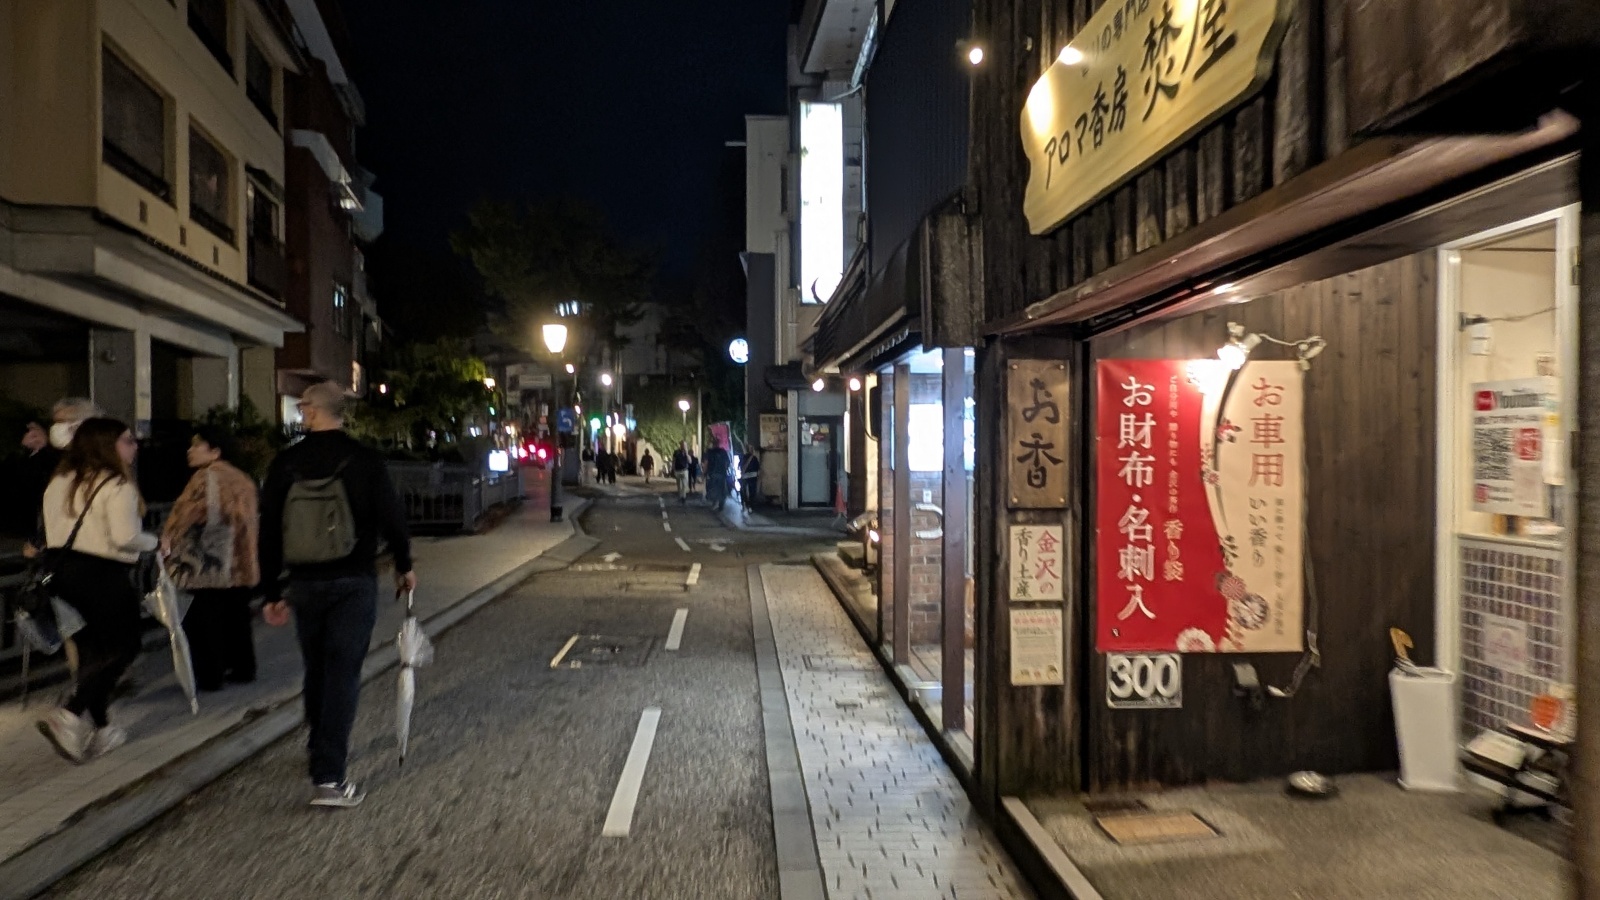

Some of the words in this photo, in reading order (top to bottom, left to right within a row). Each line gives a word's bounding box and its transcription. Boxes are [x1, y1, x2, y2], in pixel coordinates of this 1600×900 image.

[1044, 64, 1129, 190] アロマ香房
[1017, 377, 1064, 489] お香
[1247, 376, 1286, 488] お車用
[1117, 374, 1157, 621] お財布・名刺入
[1248, 496, 1269, 568] いい香り
[1014, 528, 1034, 598] 香り土産
[1034, 529, 1060, 595] 金沢の
[1109, 654, 1179, 699] 300
